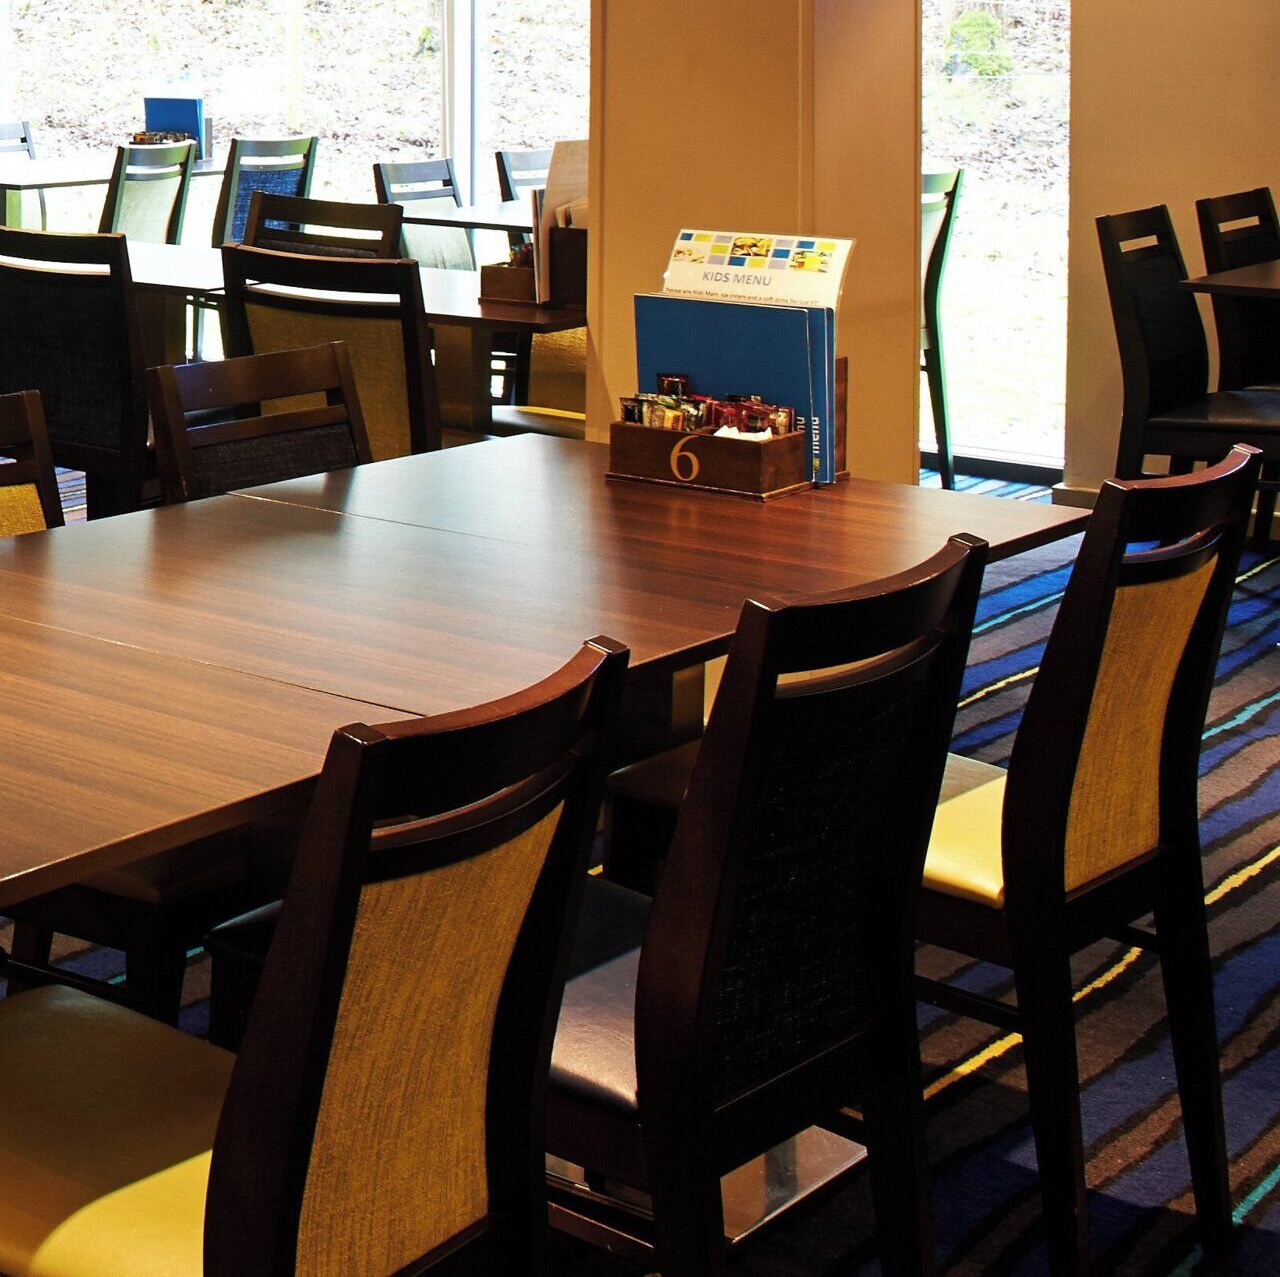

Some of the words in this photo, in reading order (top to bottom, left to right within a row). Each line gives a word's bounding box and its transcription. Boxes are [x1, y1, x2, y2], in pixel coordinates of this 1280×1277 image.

[702, 271, 730, 283] KIDS
[732, 273, 772, 286] MENU
[812, 416, 820, 454] menu
[670, 435, 700, 481] 6
